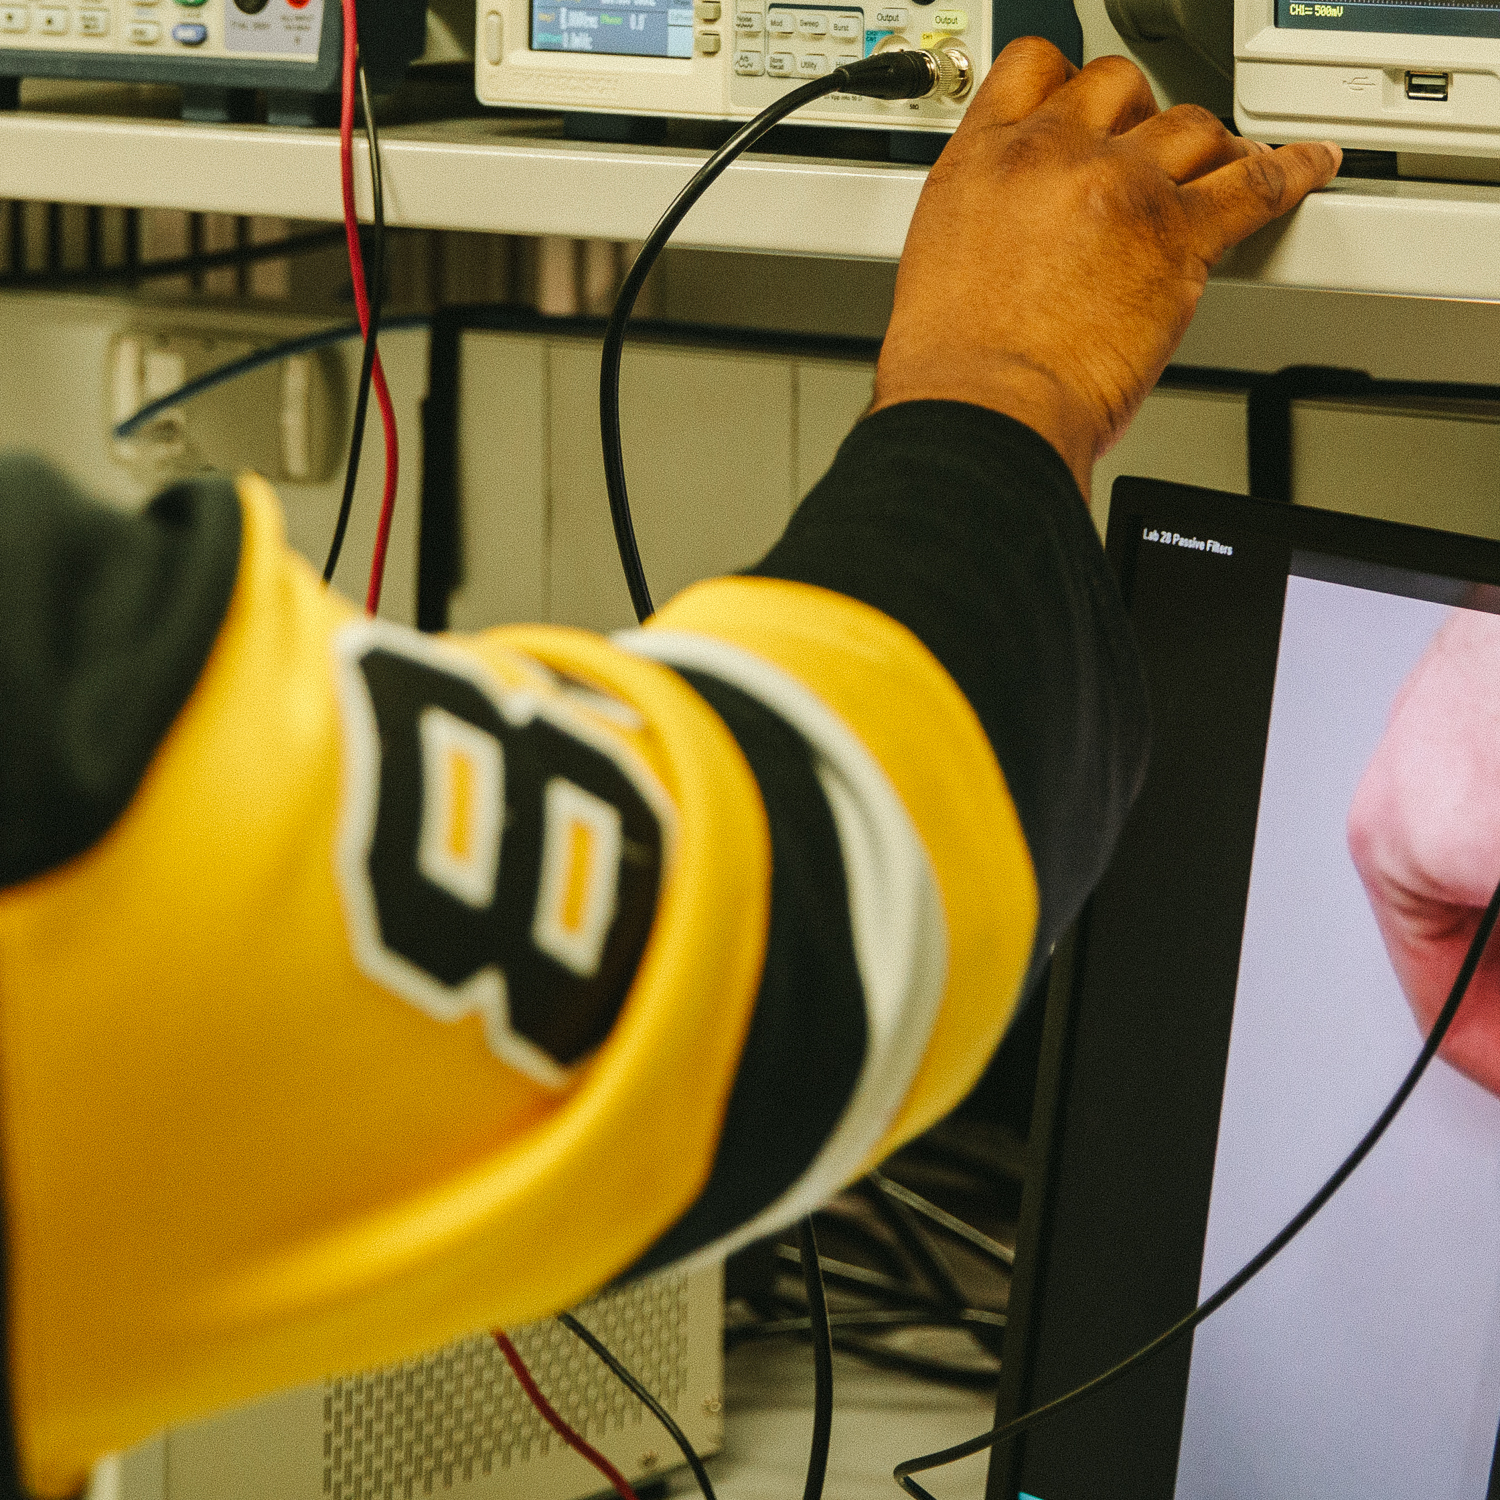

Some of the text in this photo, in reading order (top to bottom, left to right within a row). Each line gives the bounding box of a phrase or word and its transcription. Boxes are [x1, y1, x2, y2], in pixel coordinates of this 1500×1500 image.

[1314, 4, 1344, 18] 500mV
[770, 19, 783, 27] Mod
[876, 12, 900, 24] Output
[934, 15, 959, 27] Output
[799, 19, 820, 29] Sweep
[833, 23, 850, 32] Burst
[800, 61, 817, 71] Utility
[1142, 527, 1160, 543] Lab
[1172, 532, 1206, 552] Passive
[1206, 539, 1234, 556] Filters
